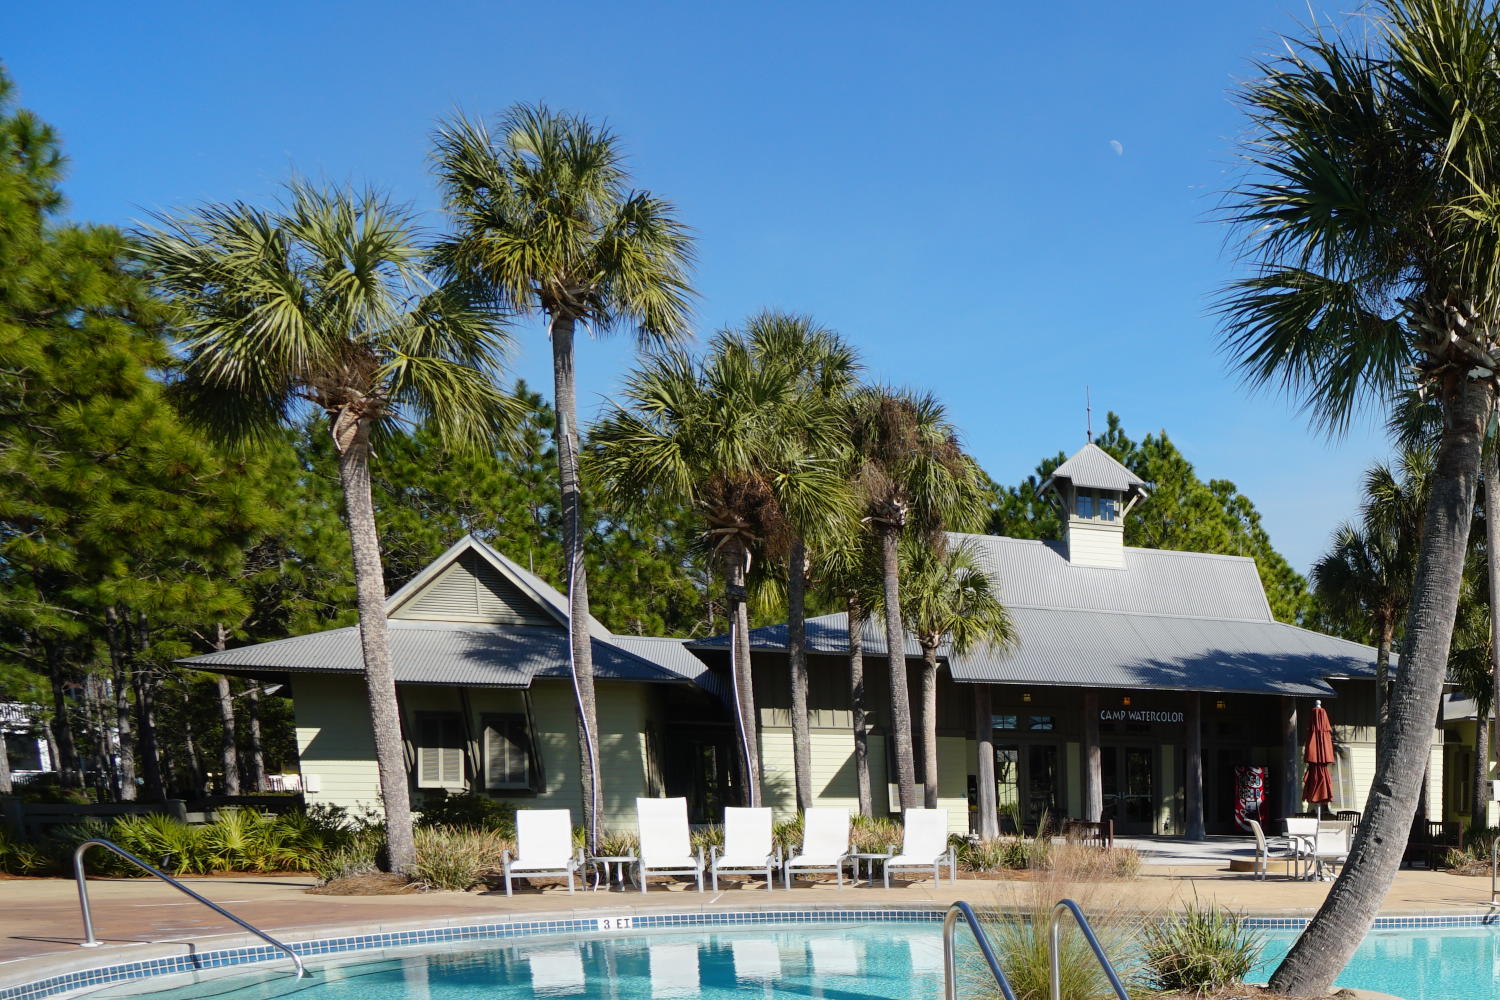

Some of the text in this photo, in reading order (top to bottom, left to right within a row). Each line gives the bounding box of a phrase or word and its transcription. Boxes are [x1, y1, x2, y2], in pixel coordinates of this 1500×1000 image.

[1100, 710, 1184, 722] CAMP WATERCOLOR
[603, 919, 610, 930] 3
